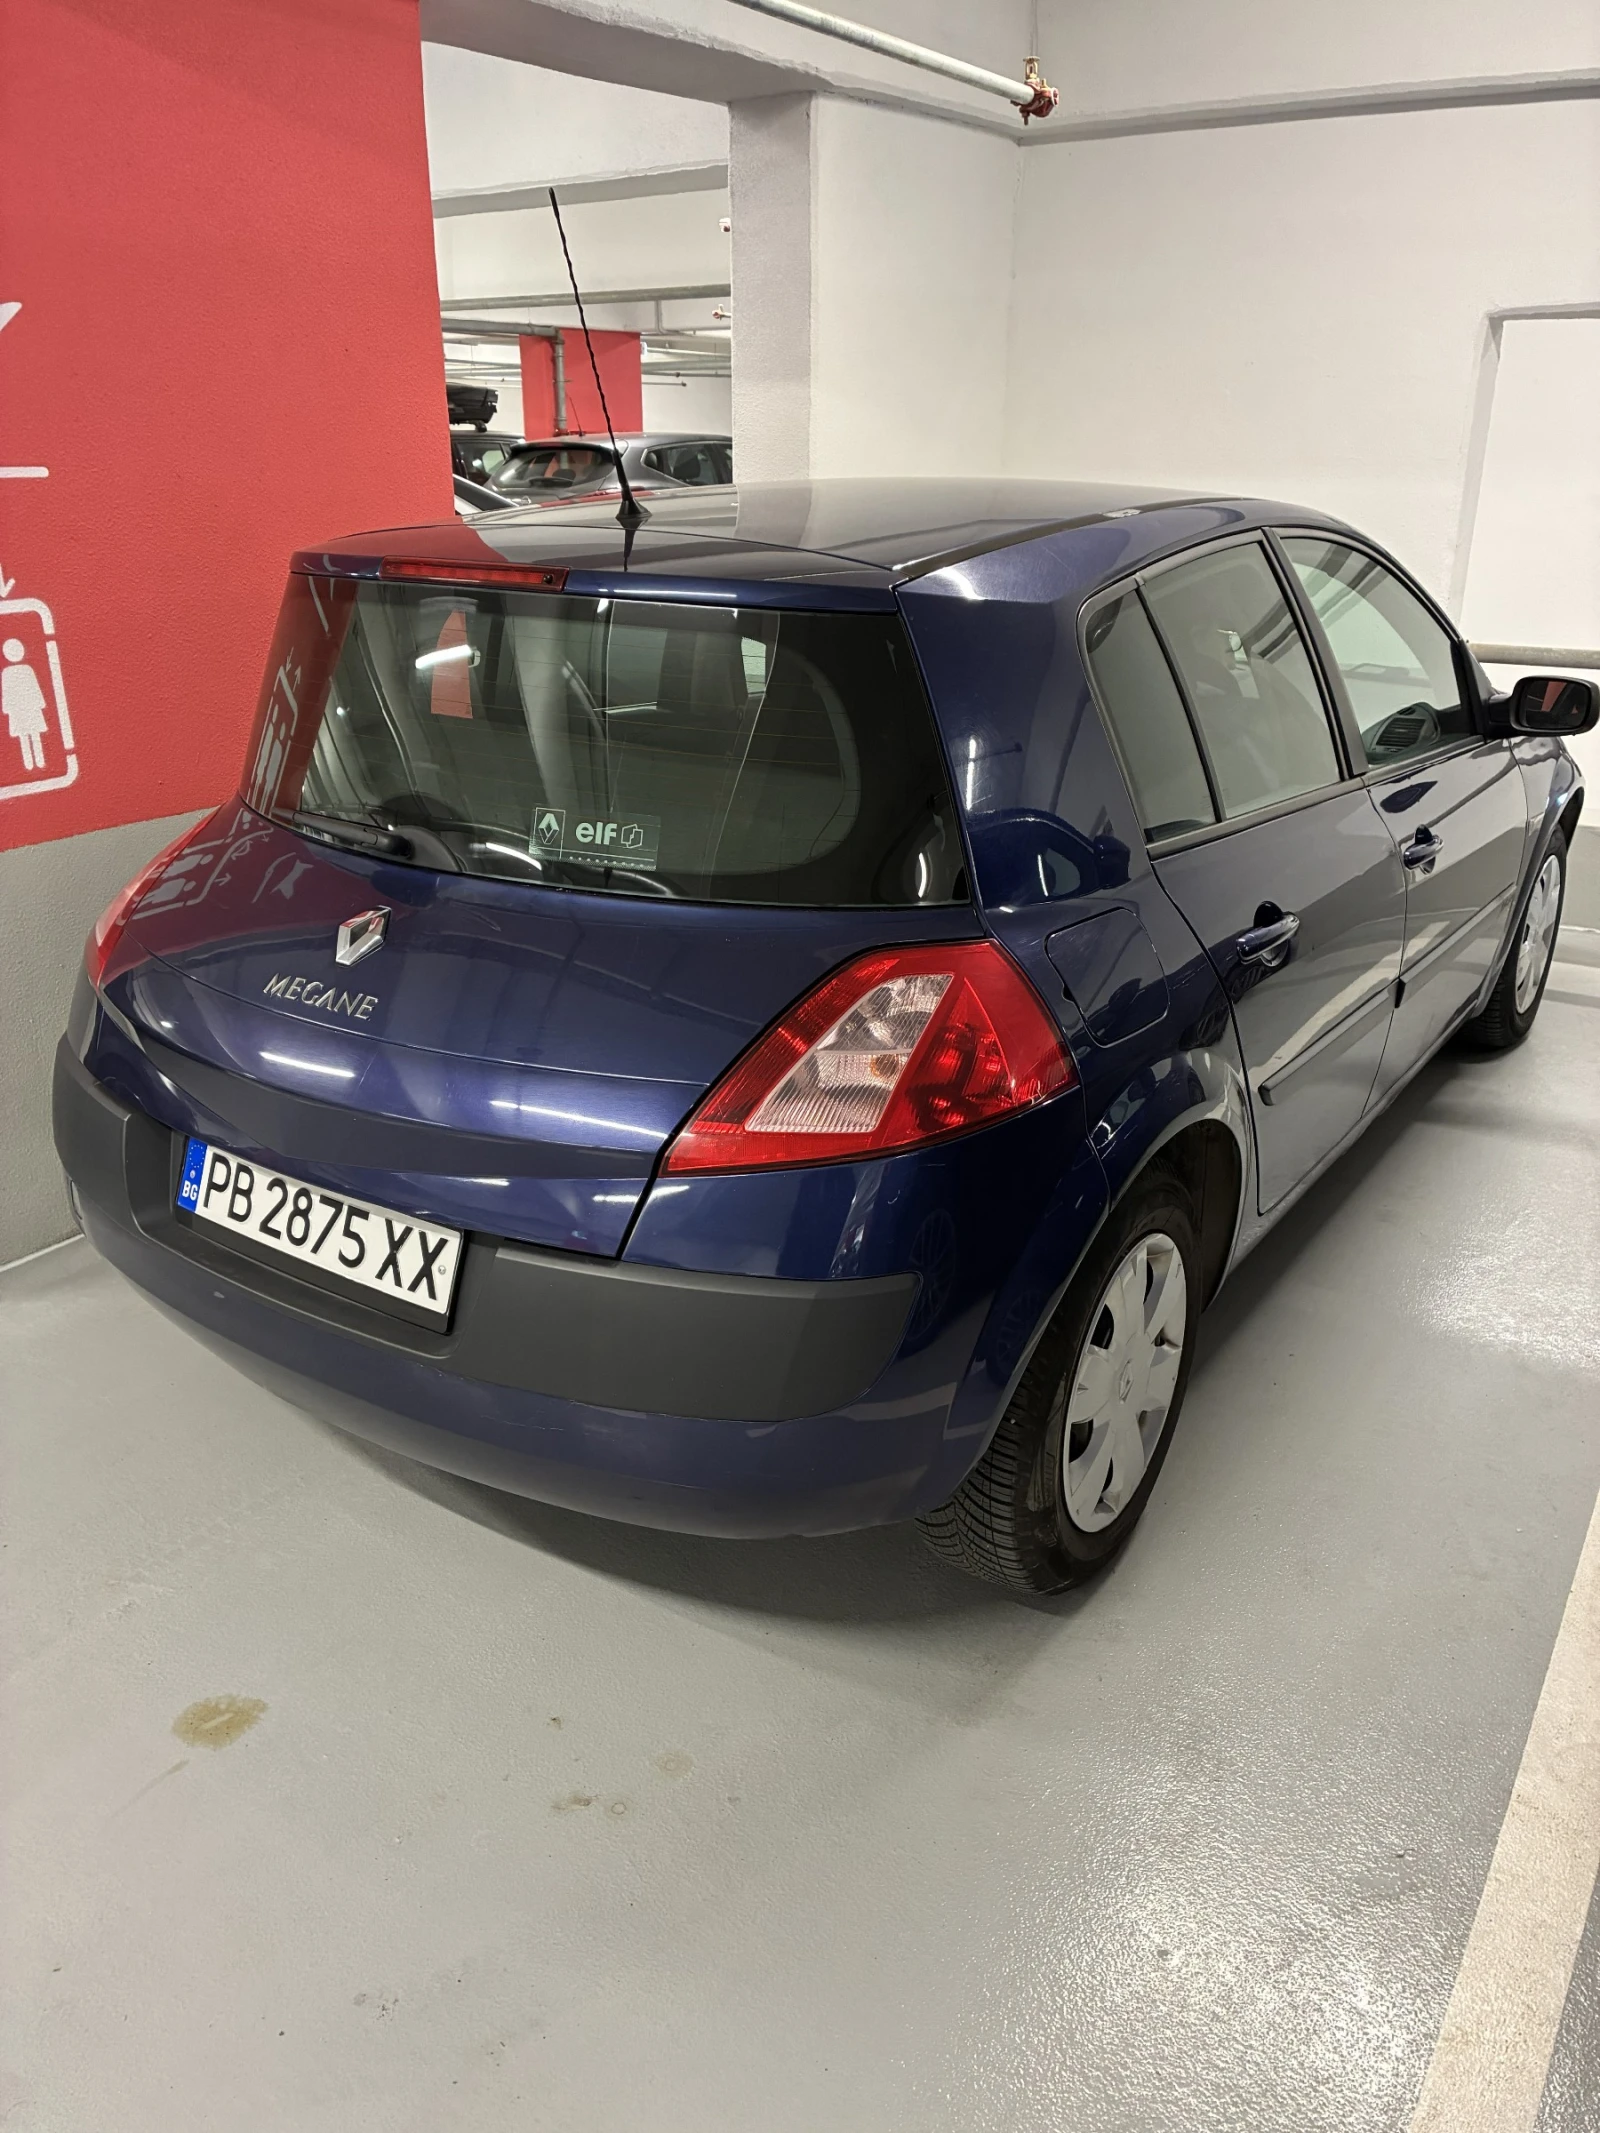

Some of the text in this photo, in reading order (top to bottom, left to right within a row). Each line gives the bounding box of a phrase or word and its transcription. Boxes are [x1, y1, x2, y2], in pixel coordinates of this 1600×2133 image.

[575, 821, 618, 846] elf
[262, 972, 379, 1021] MEGANE
[182, 1180, 199, 1201] BG
[203, 1152, 449, 1301] PB 2875 XX
